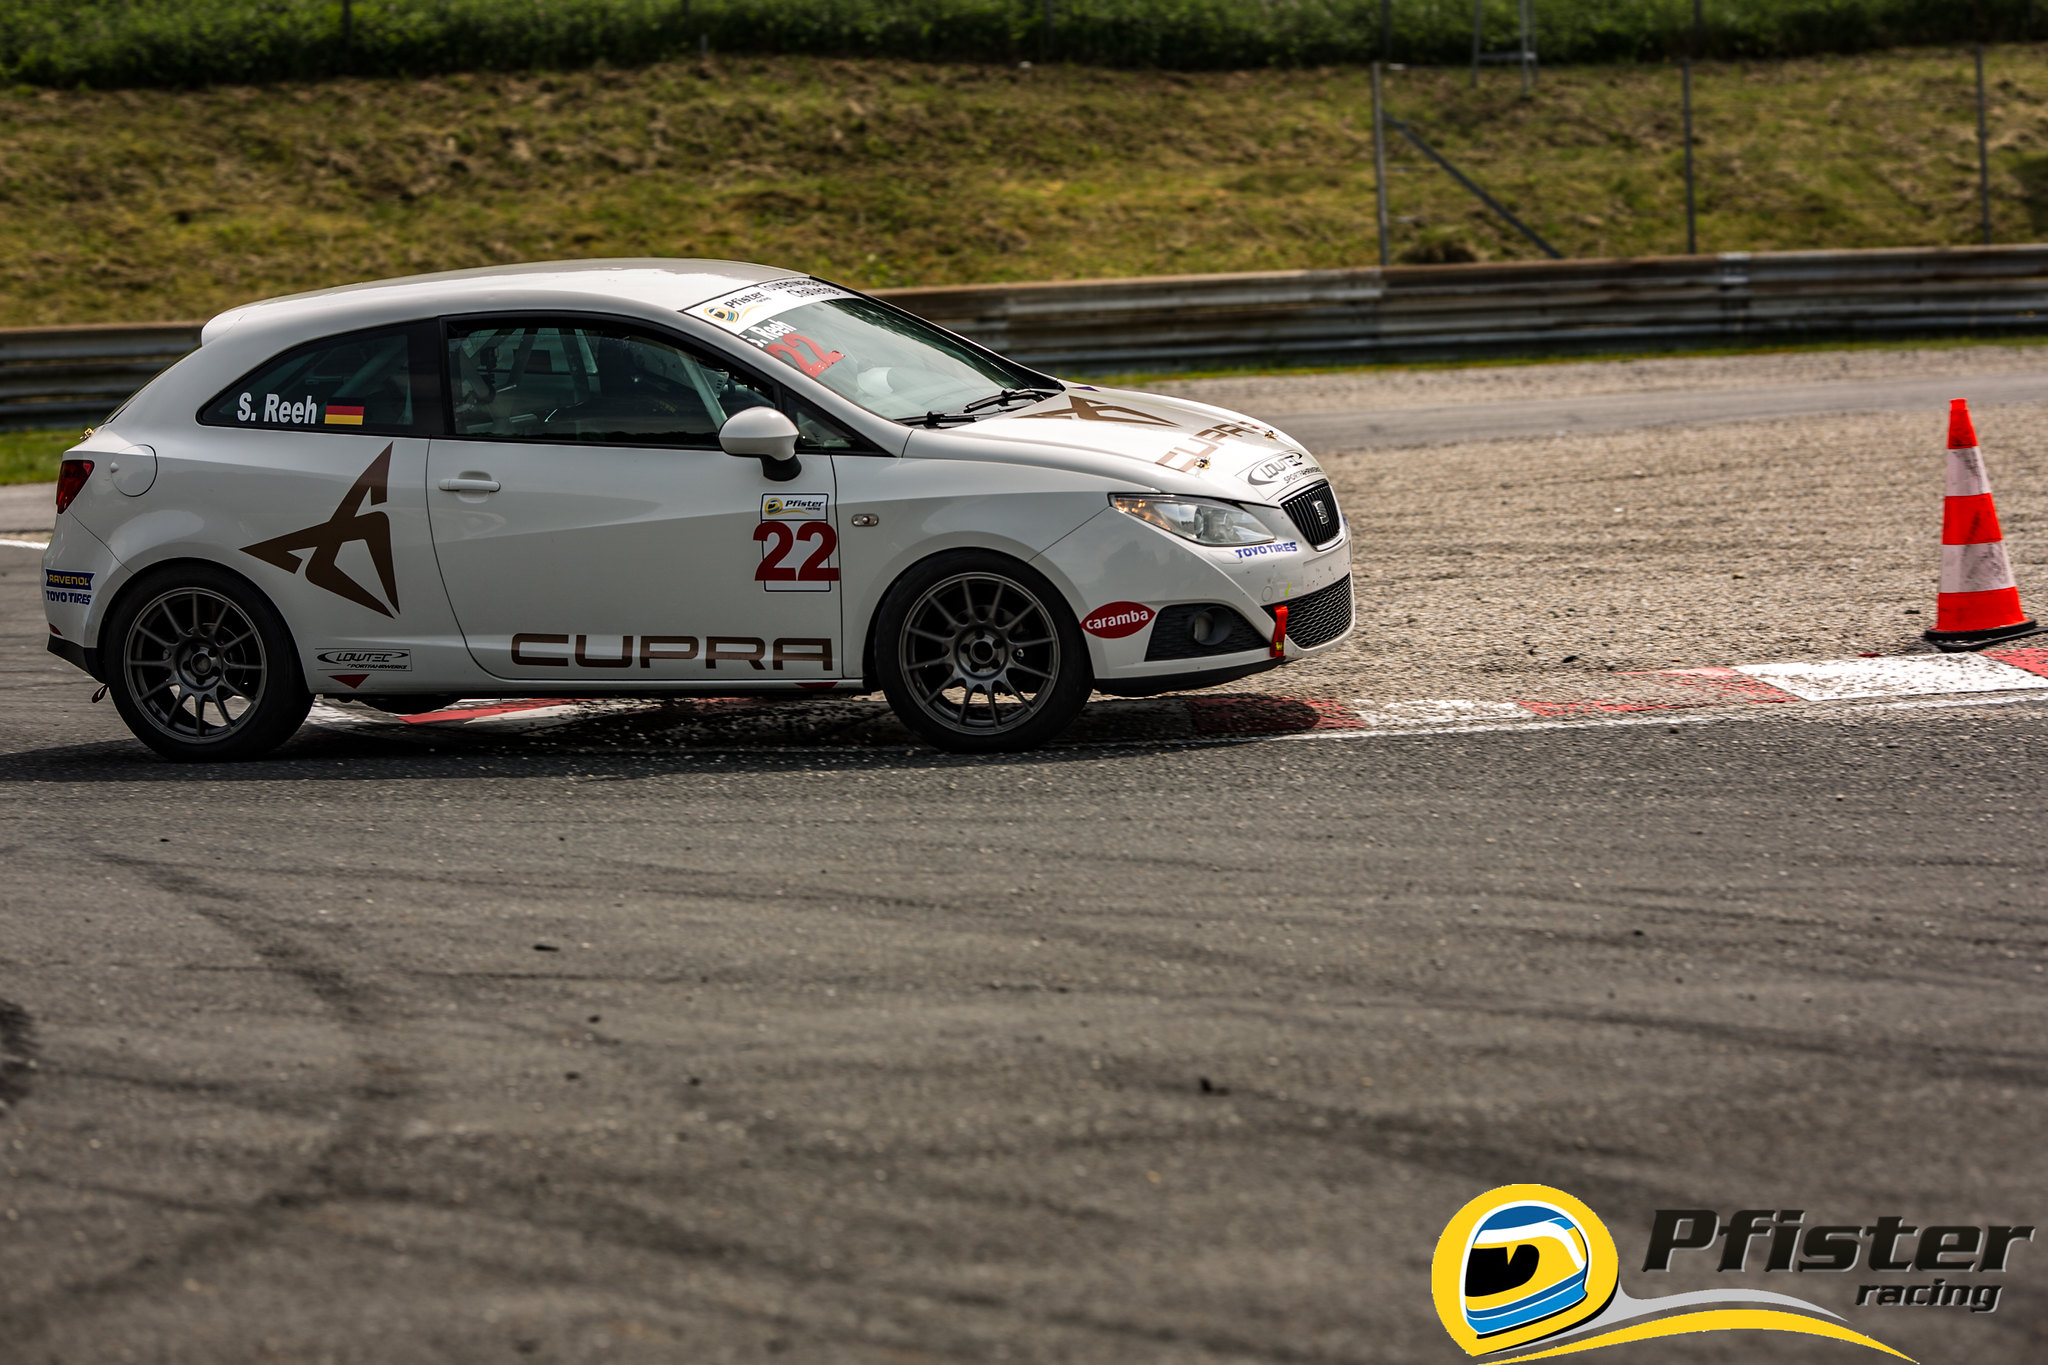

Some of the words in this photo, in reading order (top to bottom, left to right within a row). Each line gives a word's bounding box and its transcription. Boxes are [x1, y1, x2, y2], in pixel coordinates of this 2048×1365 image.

[724, 291, 764, 309] Pfister
[749, 319, 797, 340] Reeh
[765, 333, 846, 378] 22
[237, 392, 257, 421] S.
[263, 393, 317, 424] Reeh
[753, 521, 840, 581] 22
[1235, 545, 1267, 559] TOYO
[1267, 542, 1298, 553] TIRES
[49, 574, 89, 586] RAVENOL
[46, 590, 67, 603] TOYO
[68, 592, 91, 605] TIRES
[1086, 610, 1149, 630] caramba
[336, 652, 393, 663] LOWTEC
[511, 632, 834, 671] CUPRA
